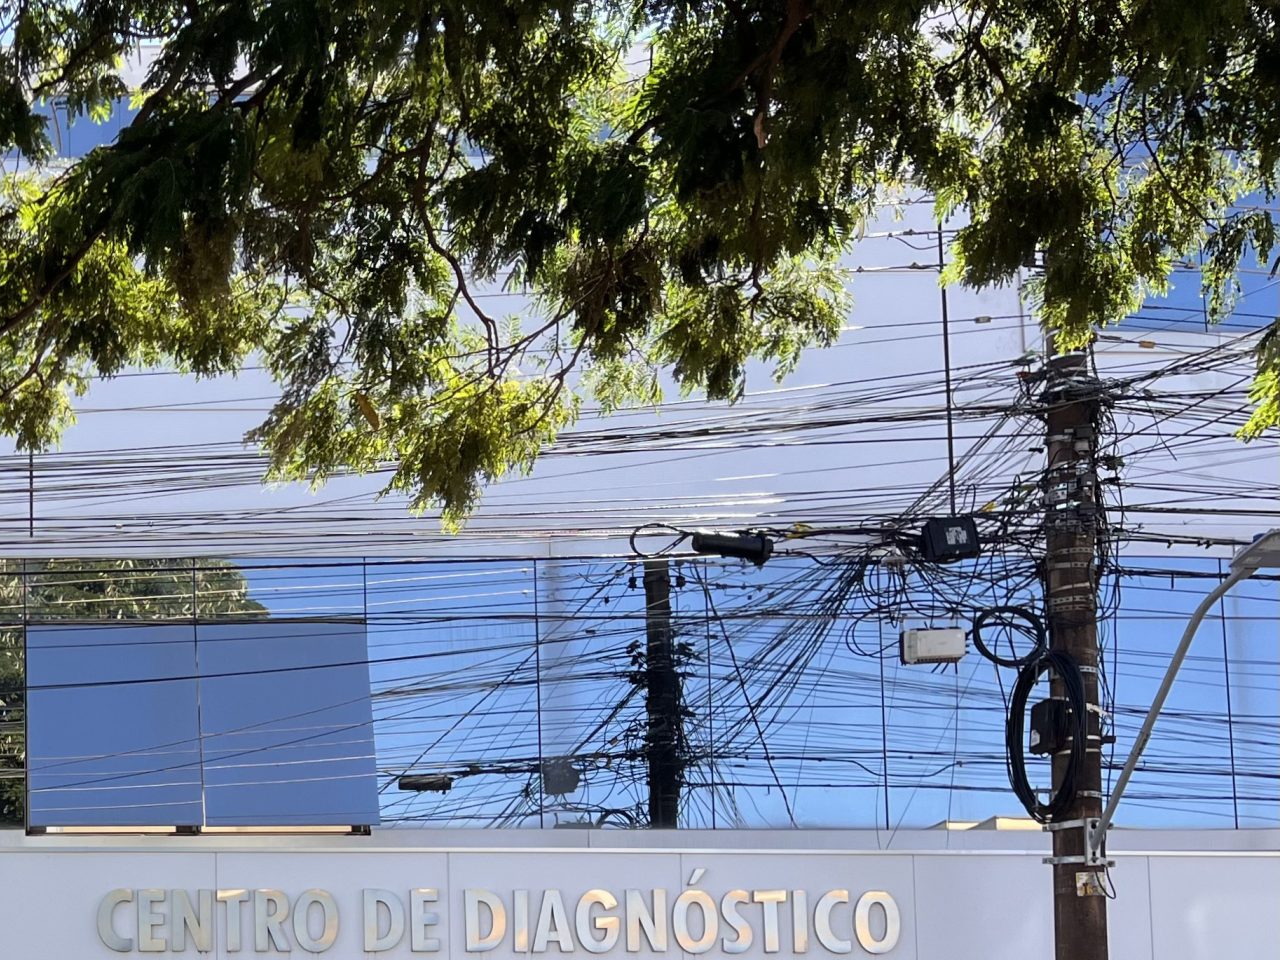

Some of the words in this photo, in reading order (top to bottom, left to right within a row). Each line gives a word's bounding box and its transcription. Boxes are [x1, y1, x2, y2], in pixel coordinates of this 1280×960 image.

[96, 887, 341, 954] CENTRO
[363, 887, 441, 953] DE
[463, 867, 902, 955] DIAGNÓSTICO
